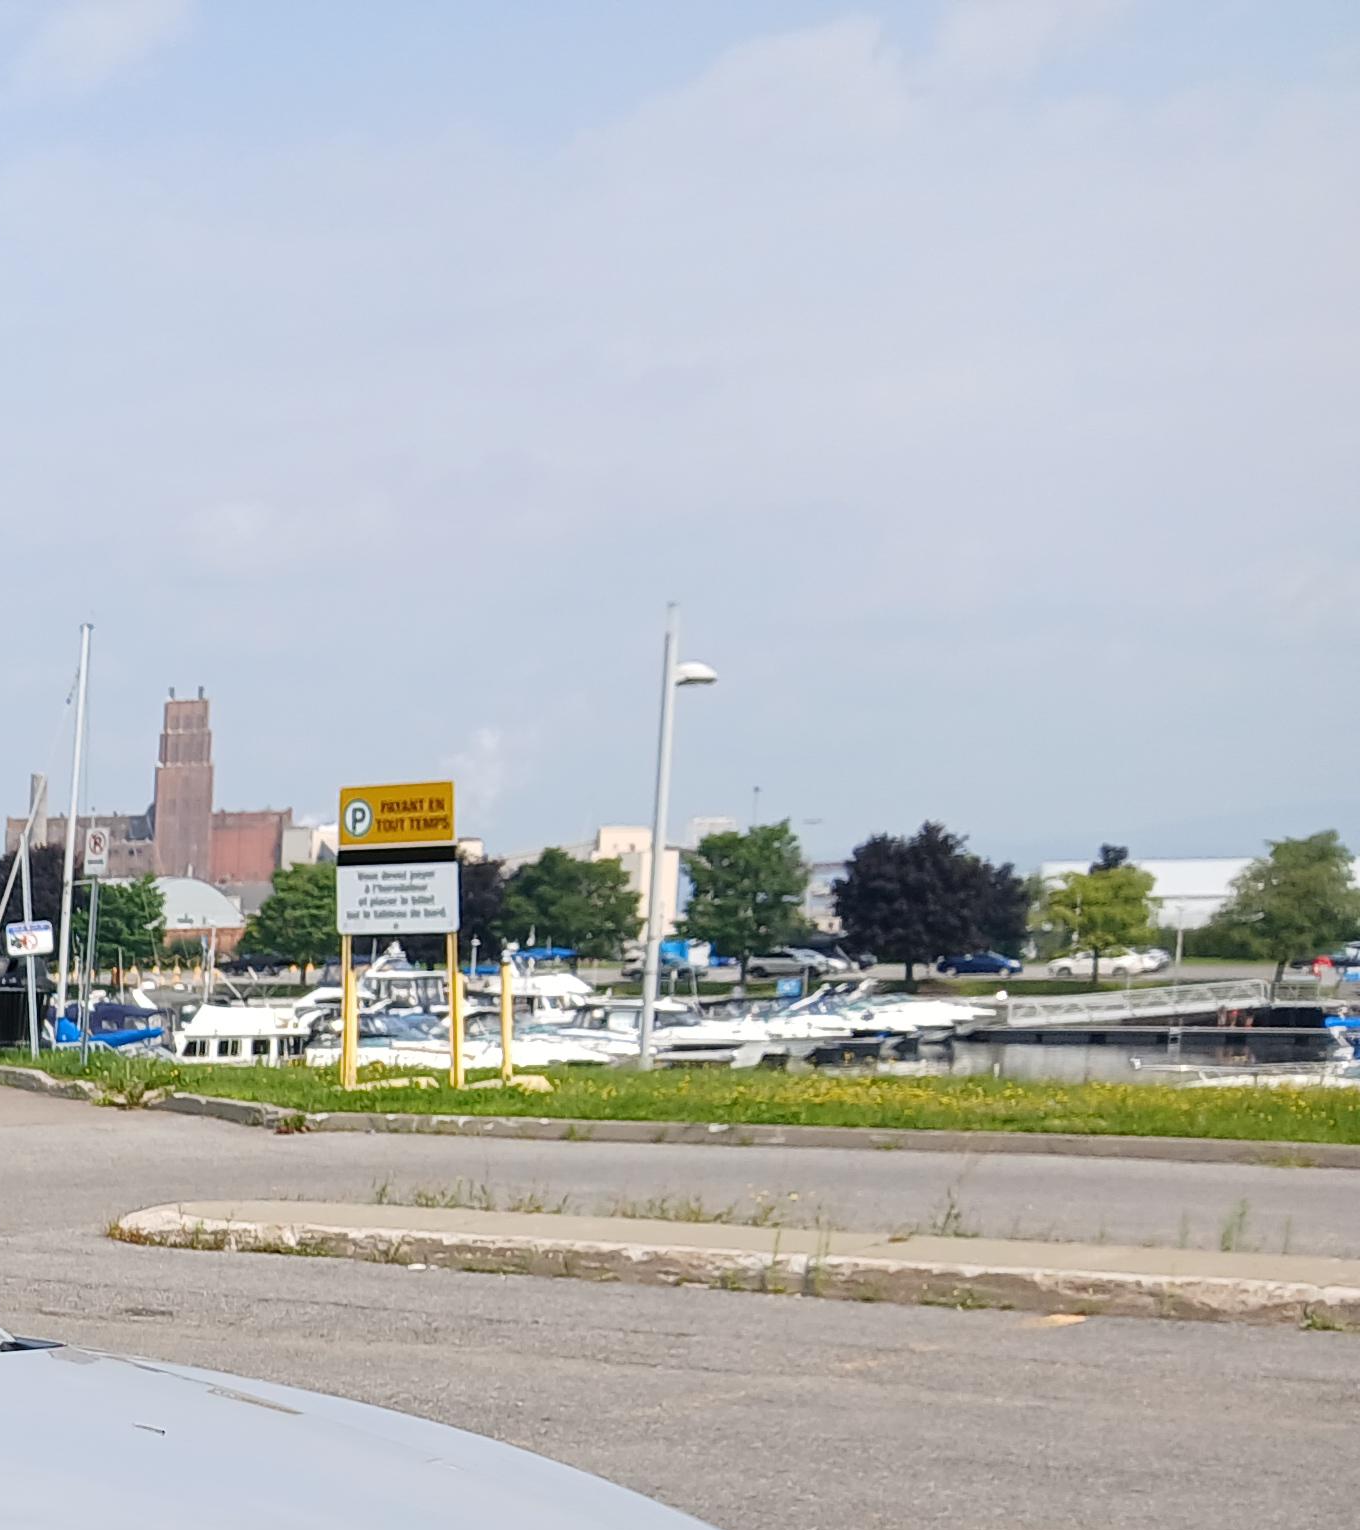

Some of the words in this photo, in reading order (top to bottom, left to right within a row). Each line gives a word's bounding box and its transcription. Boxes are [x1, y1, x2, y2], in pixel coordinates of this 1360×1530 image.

[381, 798, 425, 813] PAYANT
[428, 797, 445, 812] EN
[352, 808, 366, 830] P
[376, 817, 405, 832] TOUT
[409, 815, 449, 831] TEMPS
